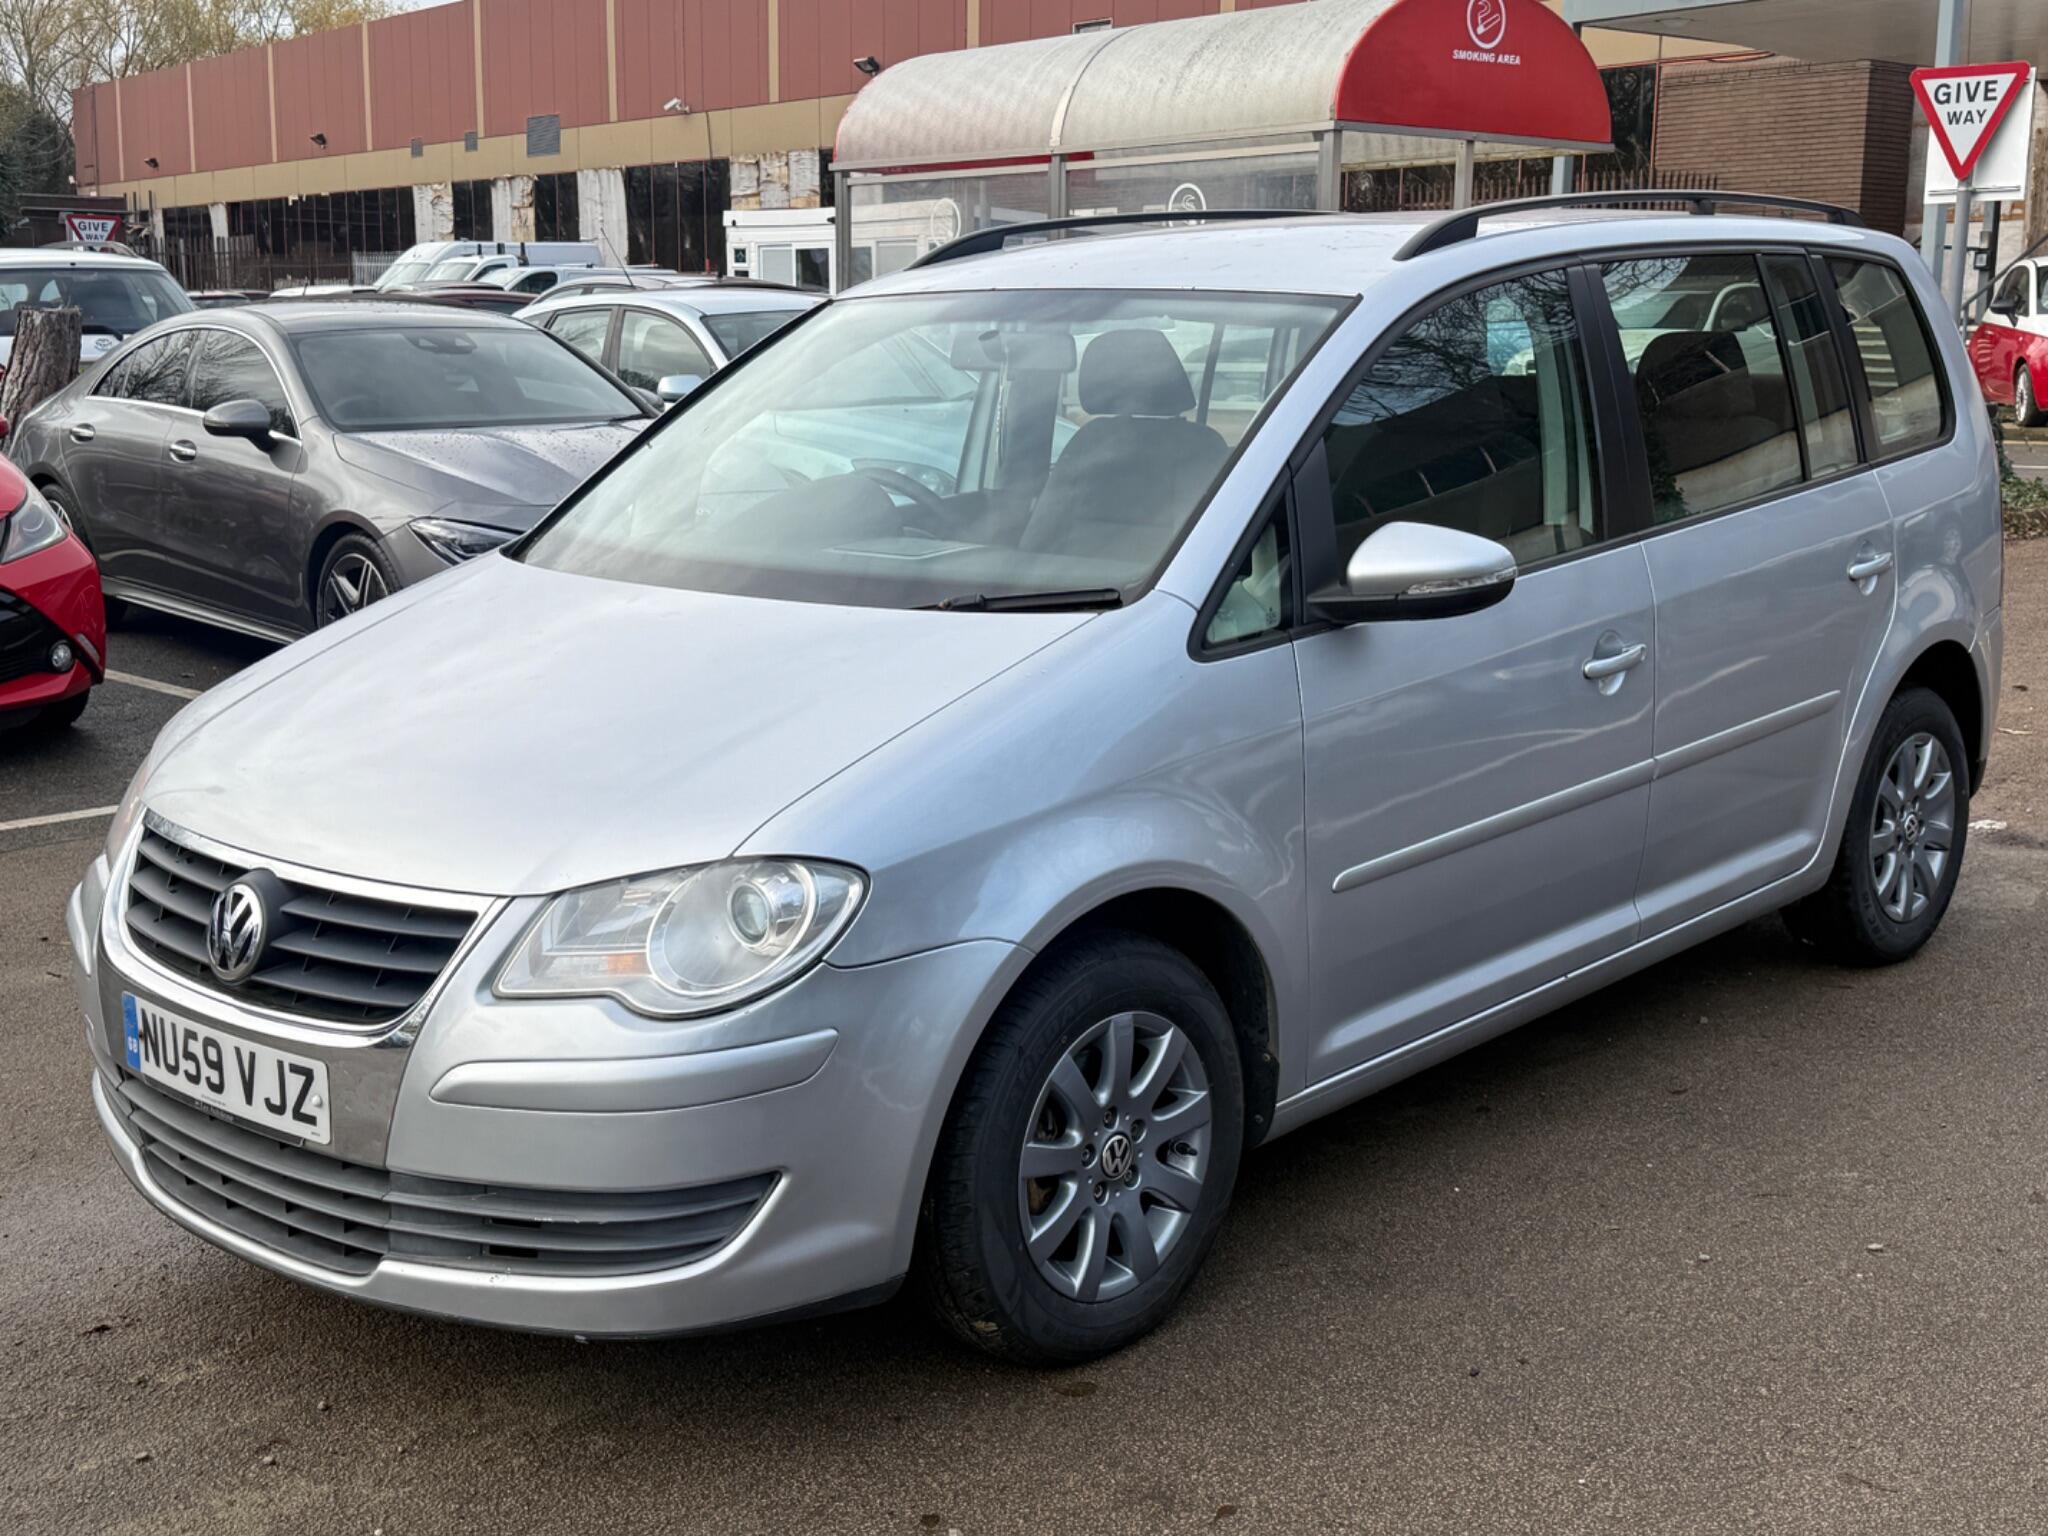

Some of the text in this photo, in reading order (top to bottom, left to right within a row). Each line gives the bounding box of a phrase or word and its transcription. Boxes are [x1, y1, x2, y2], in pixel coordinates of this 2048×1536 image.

[1452, 49, 1521, 65] SMOKING AREA
[1934, 80, 1998, 105] GIVE
[1946, 109, 1987, 126] WAY
[78, 221, 109, 232] GIVE
[86, 233, 105, 241] WAY
[141, 1008, 225, 1095] NU59
